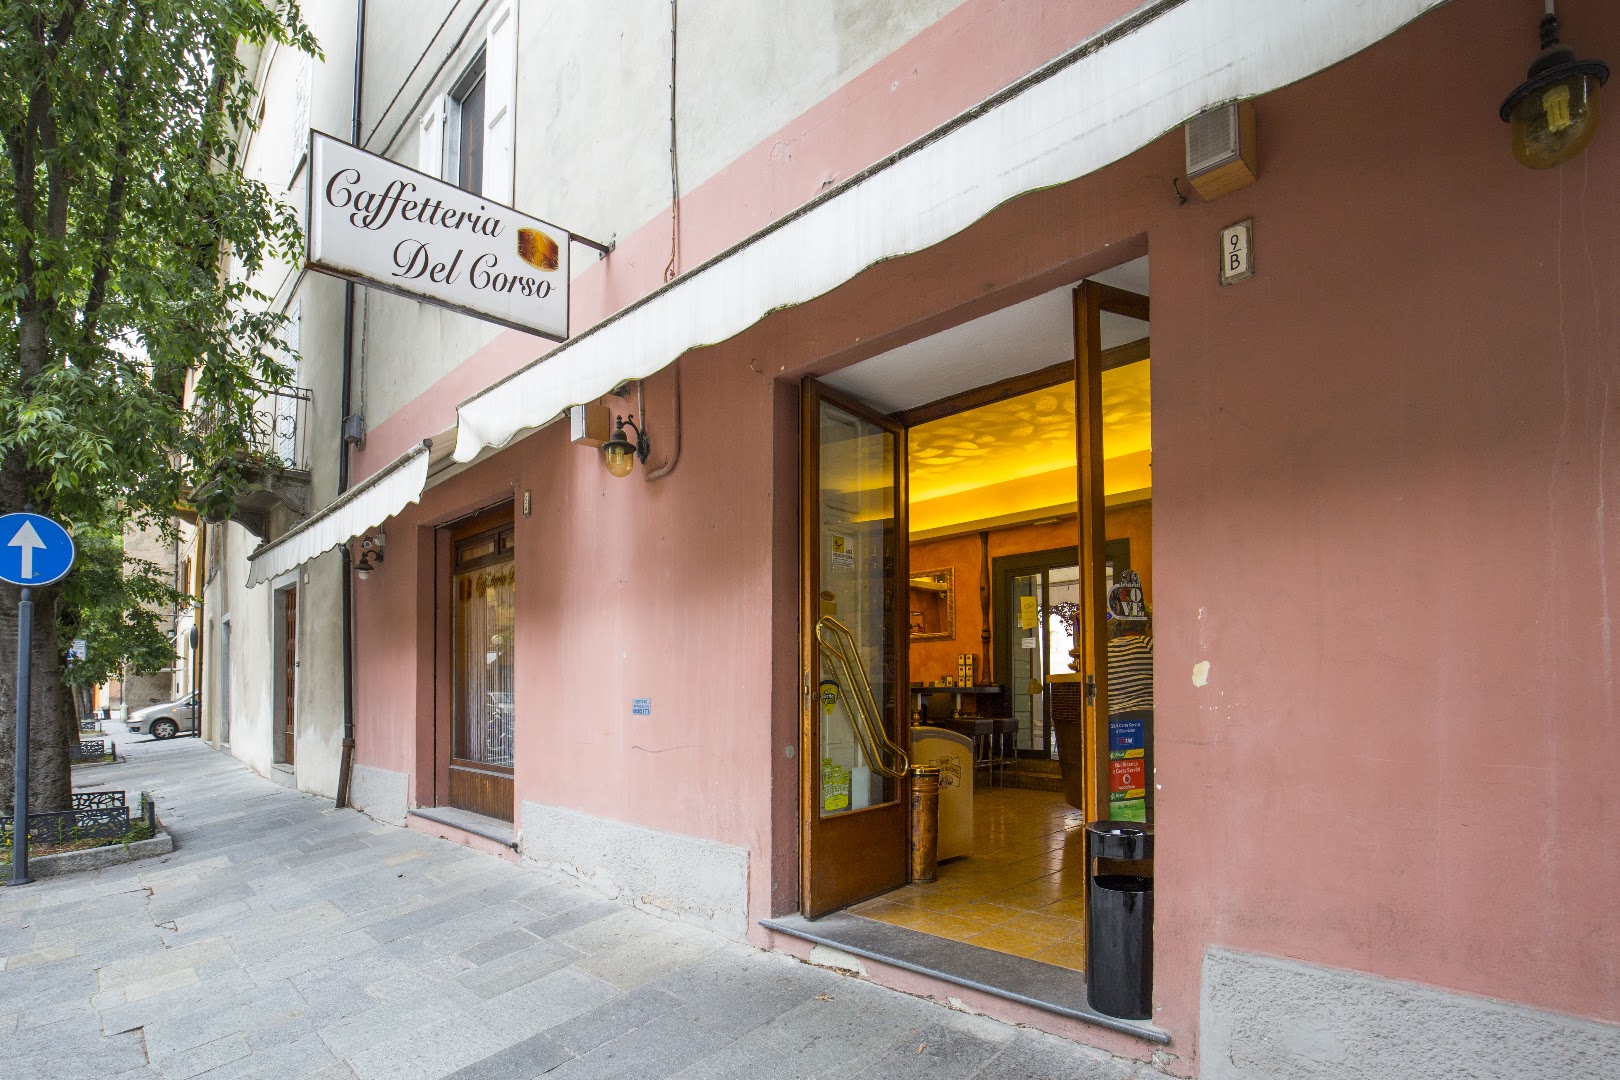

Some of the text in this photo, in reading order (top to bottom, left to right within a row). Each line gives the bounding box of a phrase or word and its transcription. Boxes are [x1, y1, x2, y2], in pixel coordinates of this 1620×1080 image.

[326, 168, 505, 238] Caffetteria
[392, 238, 556, 299] Del Corso
